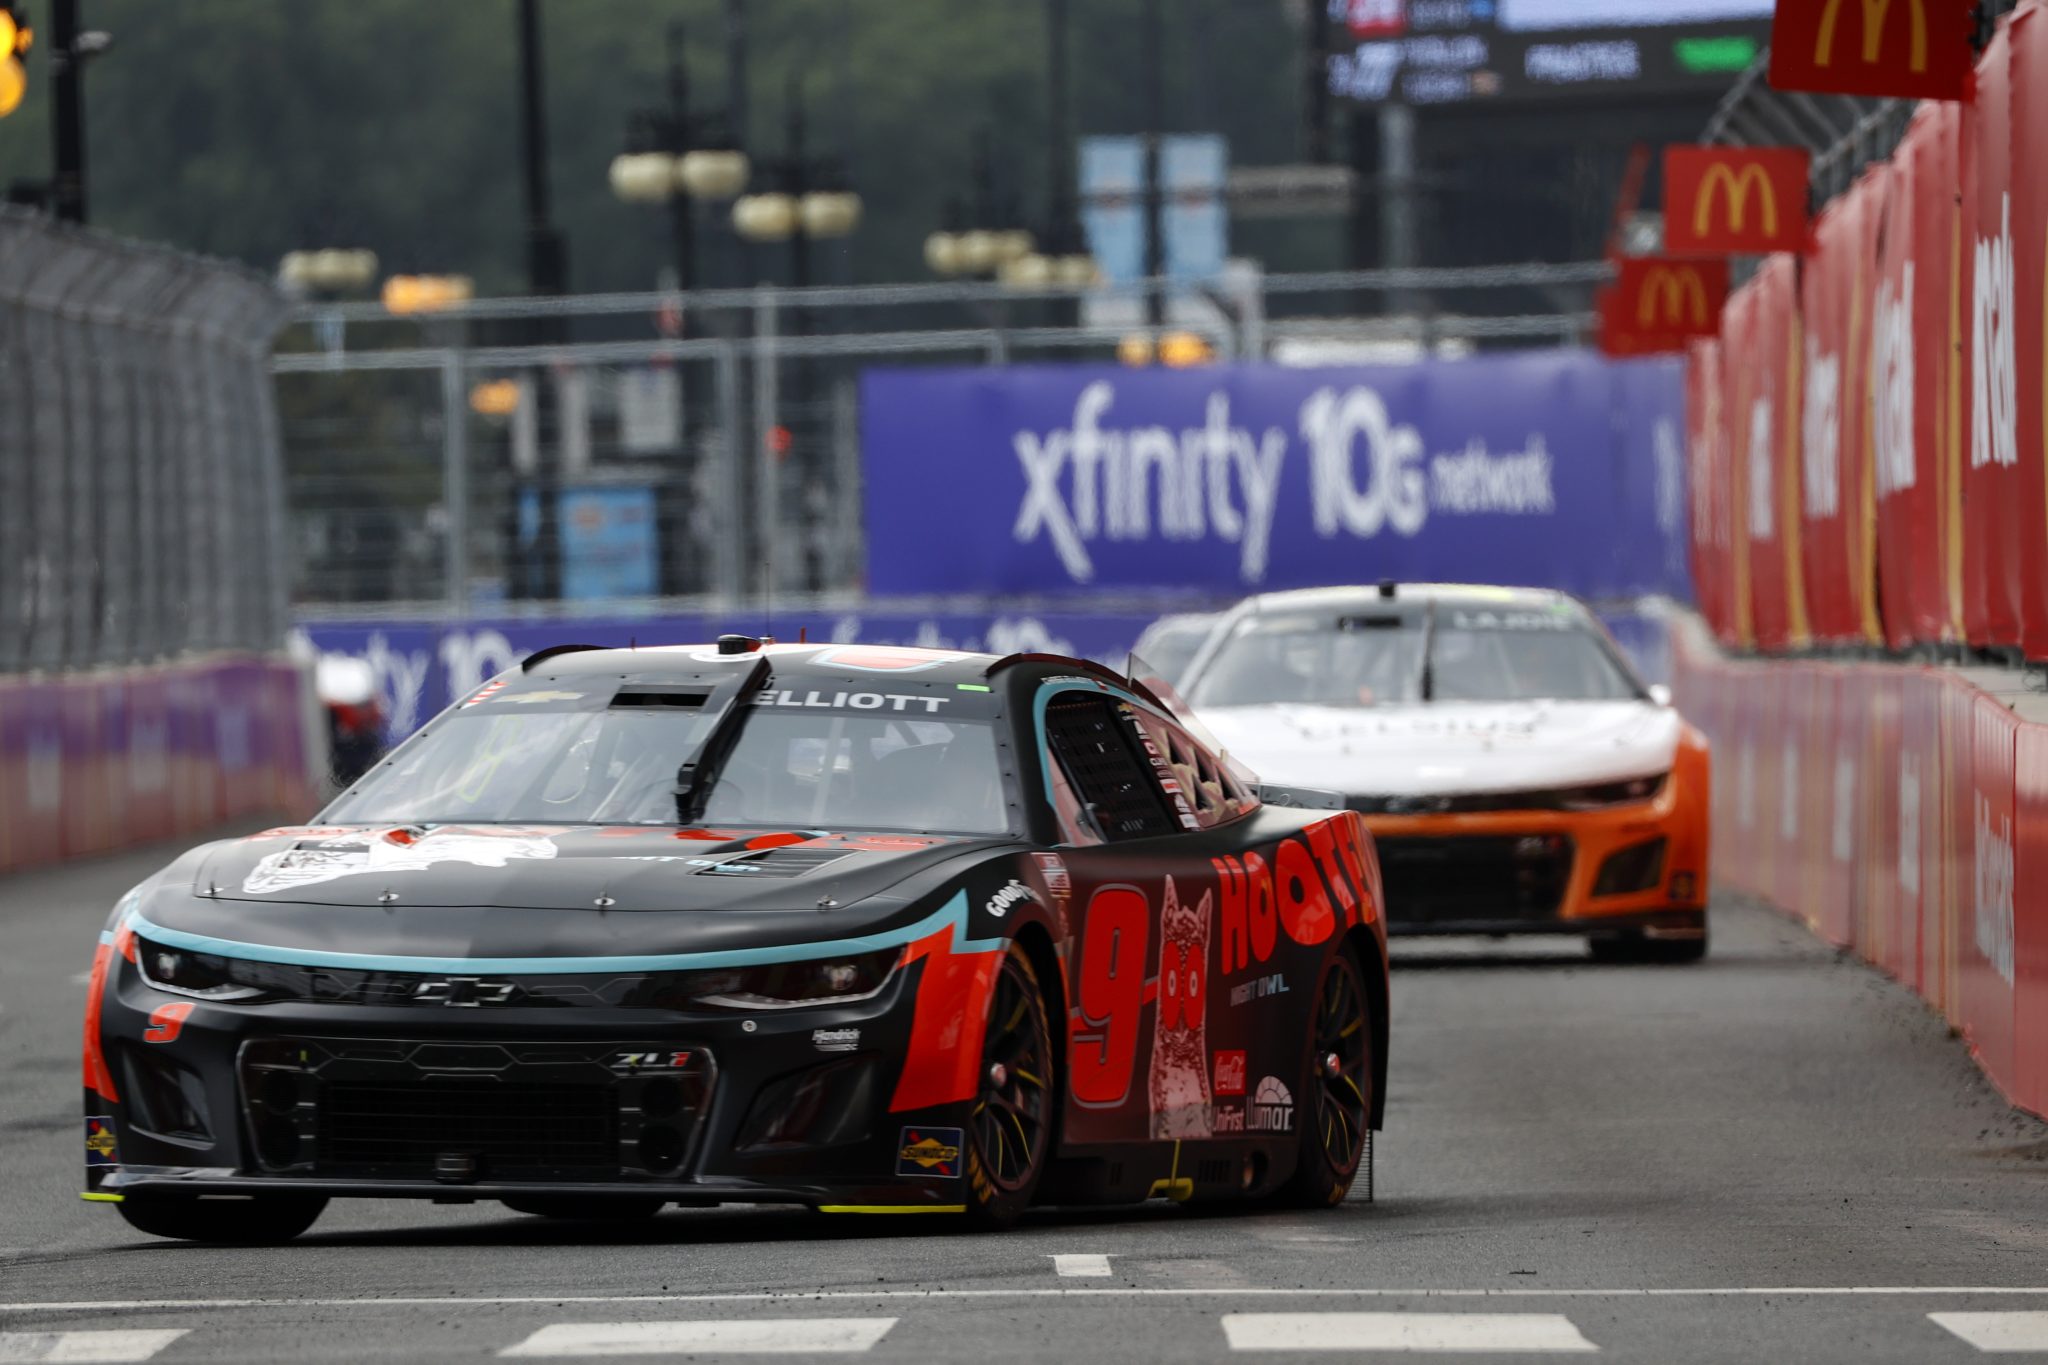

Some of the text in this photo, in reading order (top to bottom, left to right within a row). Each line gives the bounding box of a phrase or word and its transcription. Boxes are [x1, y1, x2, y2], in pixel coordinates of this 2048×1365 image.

[1012, 379, 1288, 584] xfinity
[755, 689, 950, 713] ELLIOTT
[143, 1002, 197, 1043] 9
[1070, 883, 1150, 1109] 9
